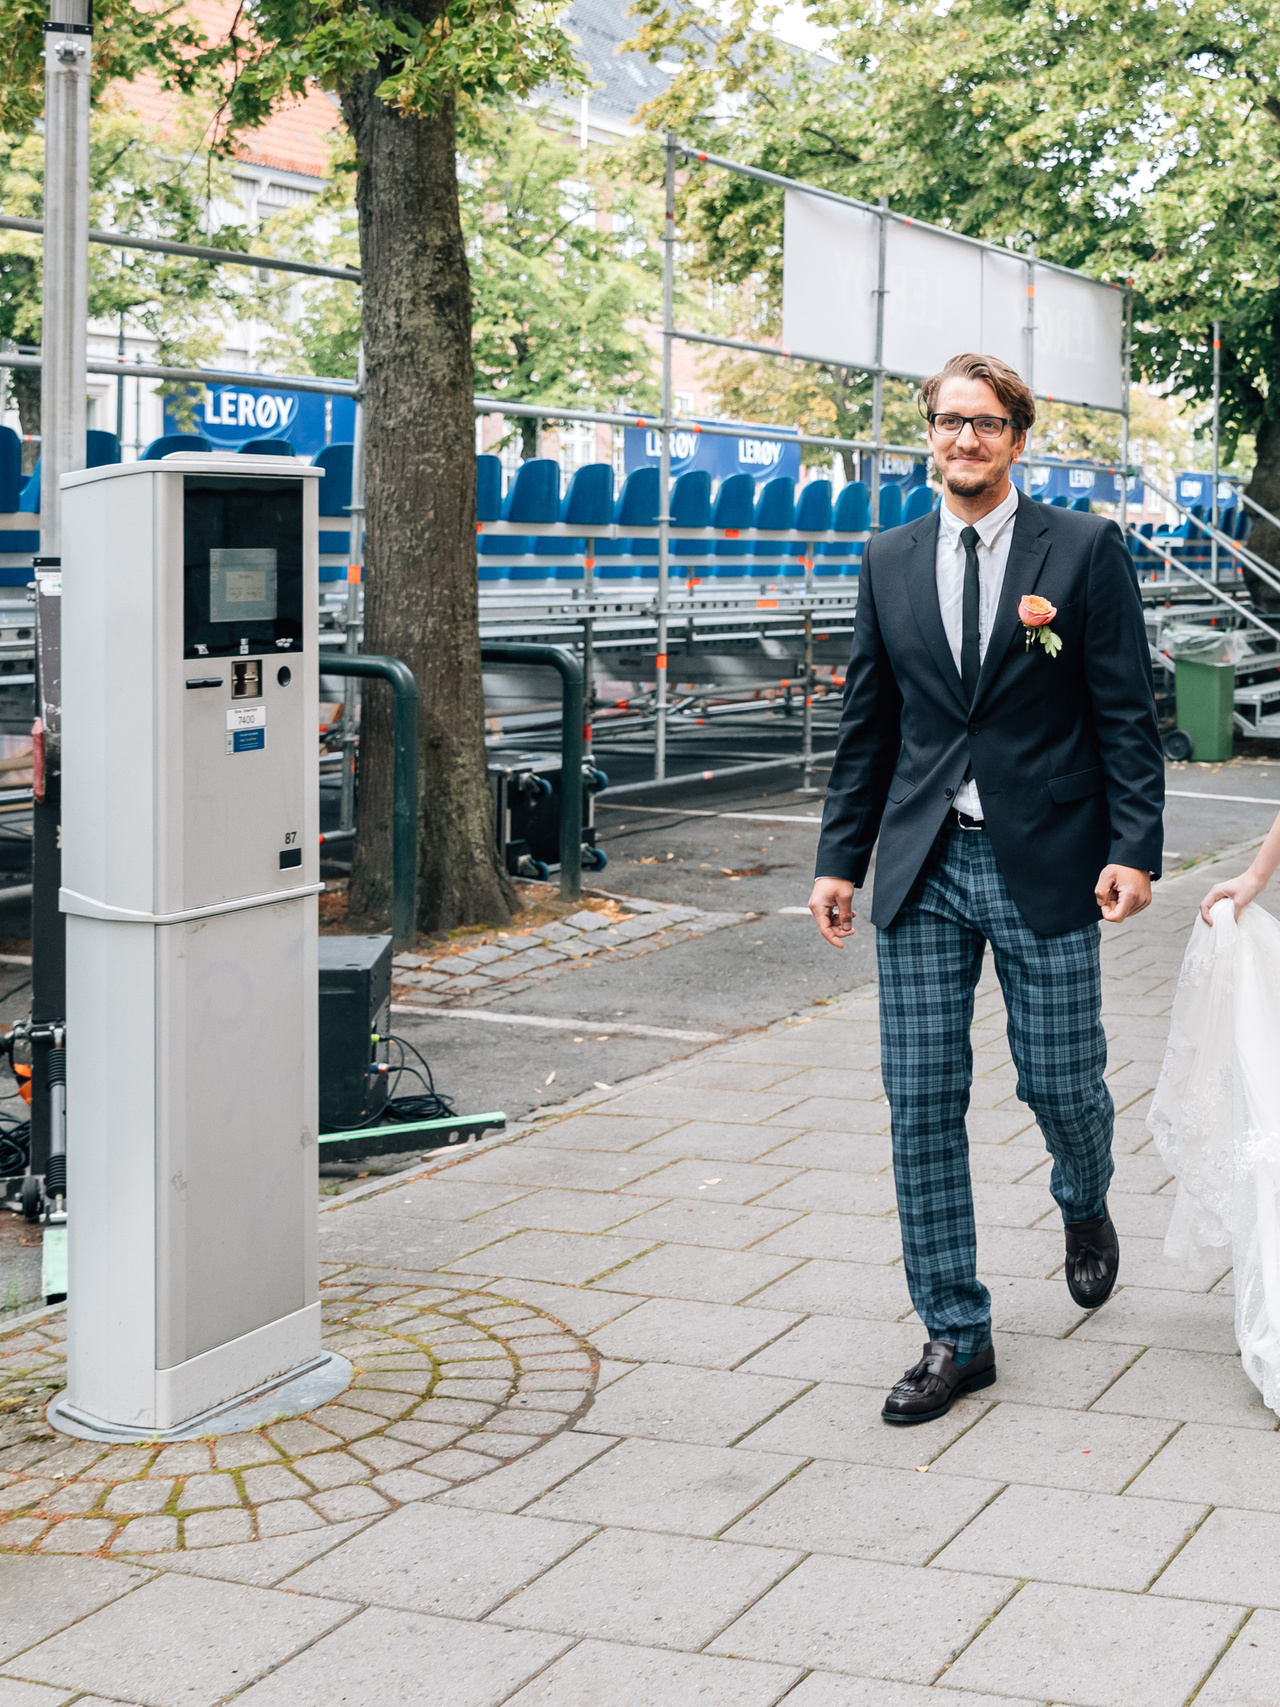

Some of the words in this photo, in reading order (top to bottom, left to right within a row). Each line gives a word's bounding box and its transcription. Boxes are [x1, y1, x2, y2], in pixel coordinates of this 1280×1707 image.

[204, 390, 294, 429] LERØY
[738, 439, 782, 466] LERØY
[238, 714, 255, 725] 7400
[284, 831, 297, 845] 87
